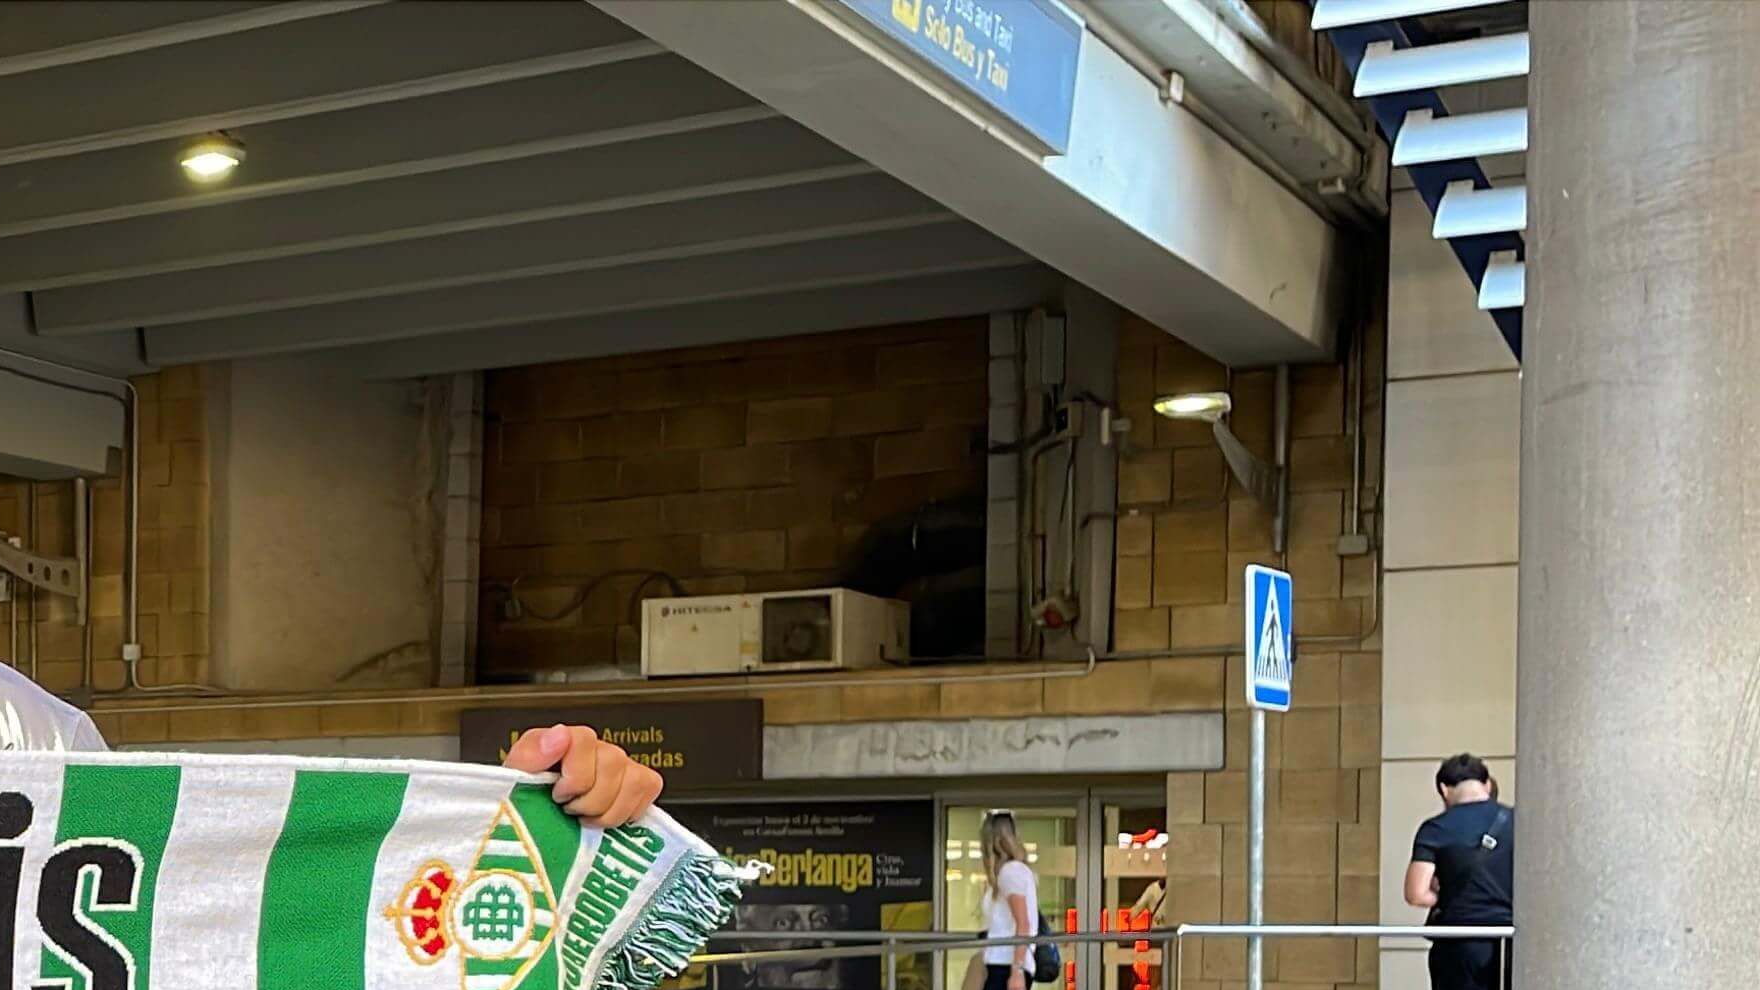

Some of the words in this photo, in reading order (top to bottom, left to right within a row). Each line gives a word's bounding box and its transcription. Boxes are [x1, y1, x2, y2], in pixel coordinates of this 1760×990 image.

[993, 14, 1014, 54] Taxi
[953, 25, 976, 68] Bus
[987, 48, 1010, 91] Taxi
[602, 725, 665, 744] Arrivals
